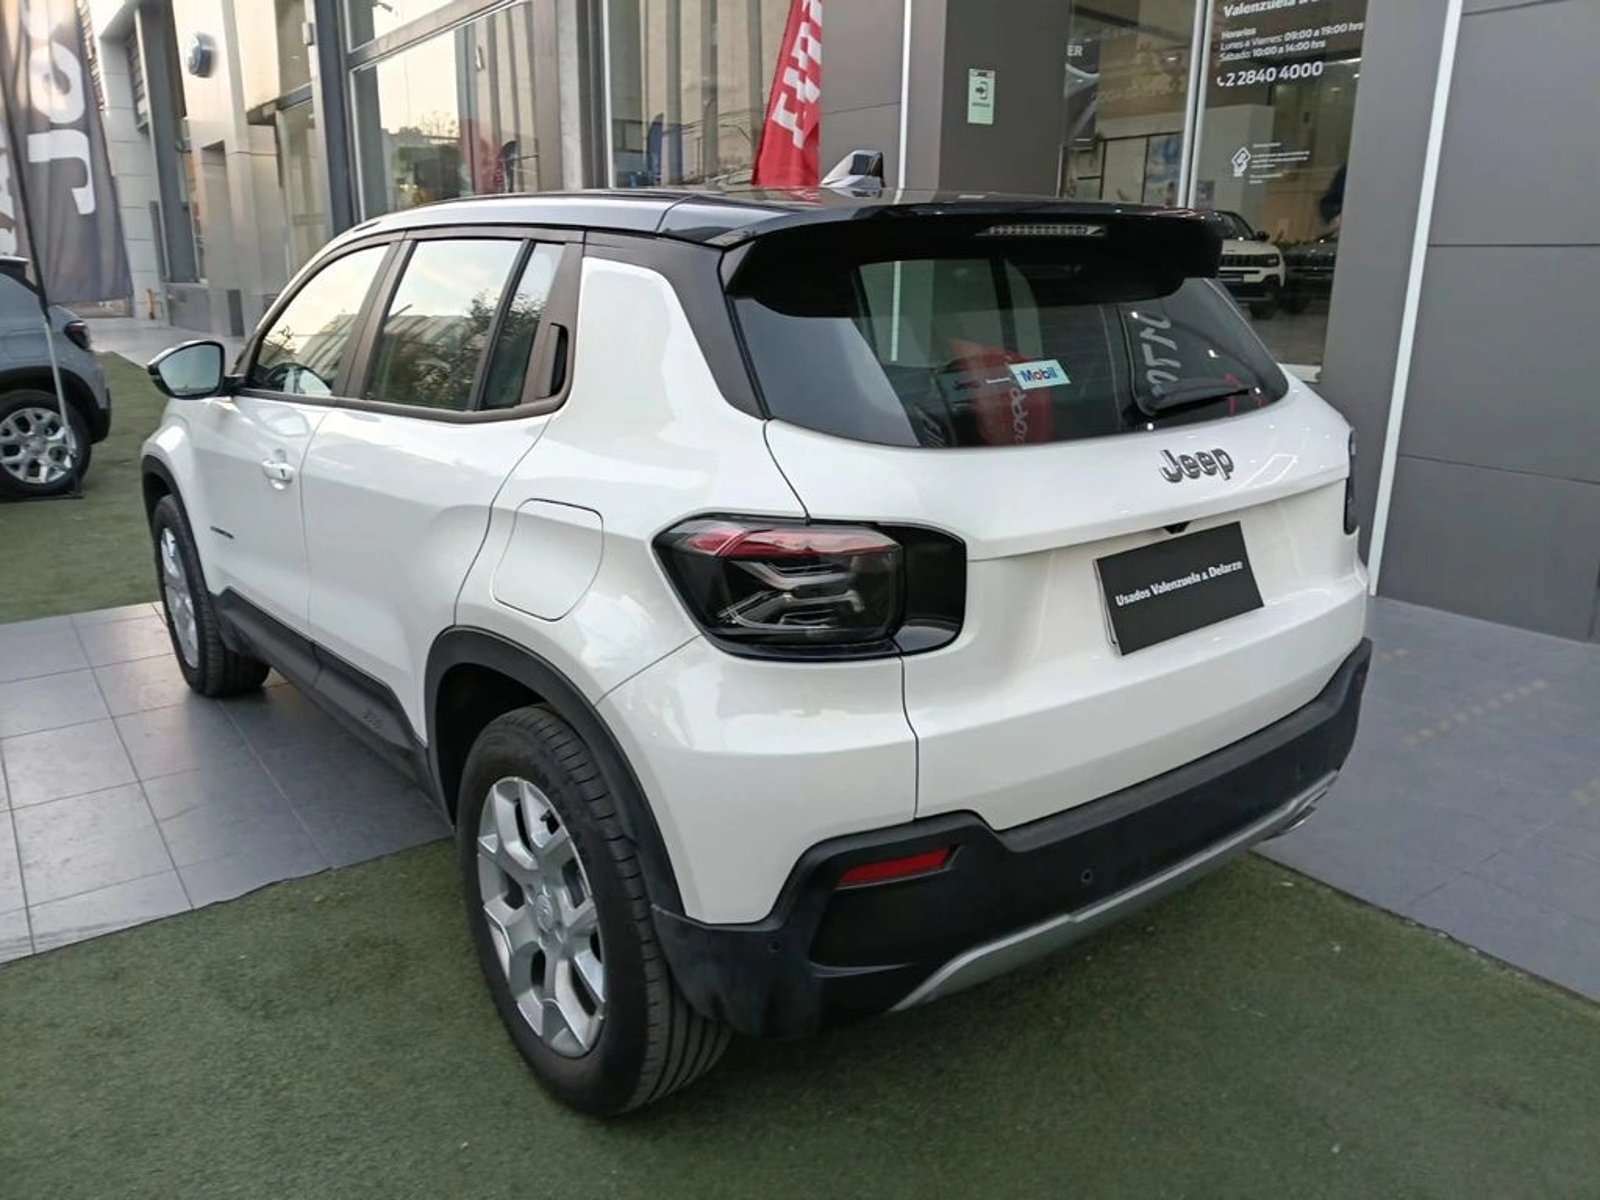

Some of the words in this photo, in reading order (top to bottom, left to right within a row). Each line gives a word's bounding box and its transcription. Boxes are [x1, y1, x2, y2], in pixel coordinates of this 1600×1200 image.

[1236, 67, 1277, 86] 2840
[1278, 61, 1323, 80] 4000
[1019, 366, 1058, 383] Mobil
[1159, 448, 1234, 483] Jeep
[1115, 588, 1151, 607] Usados
[1150, 571, 1201, 597] Valenzuela
